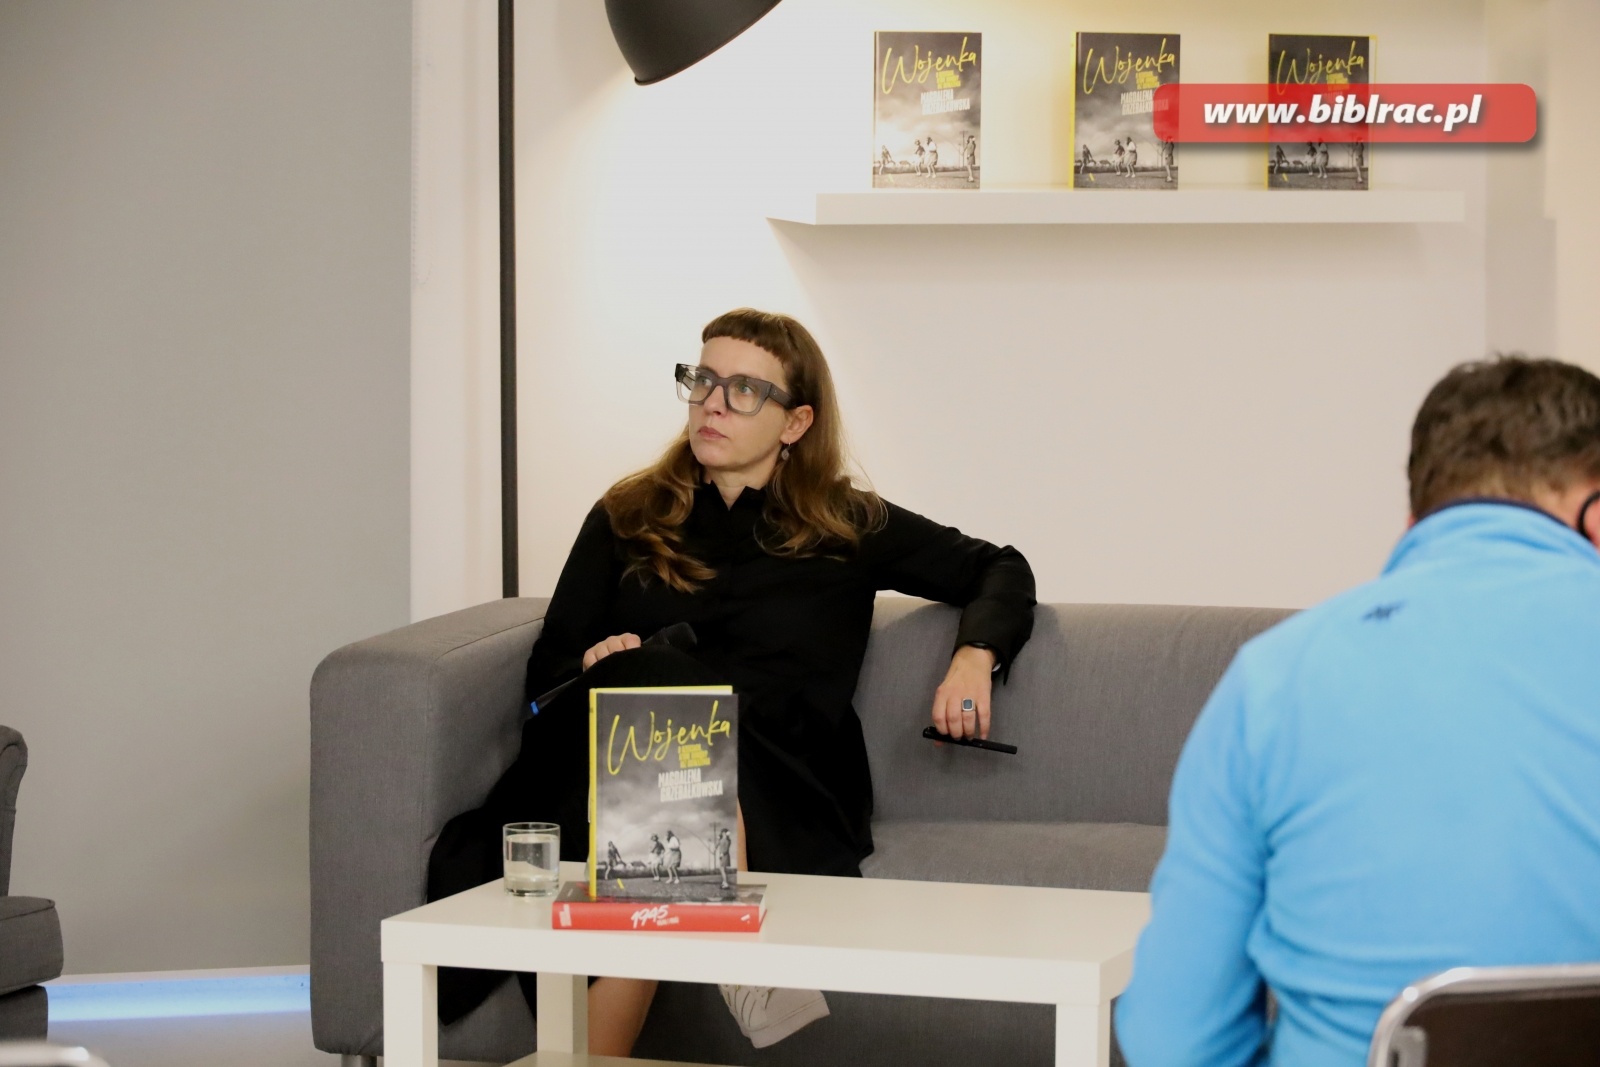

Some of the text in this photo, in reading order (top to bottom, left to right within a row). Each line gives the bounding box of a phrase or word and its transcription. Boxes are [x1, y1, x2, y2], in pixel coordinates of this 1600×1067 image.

[881, 36, 977, 95] Wojenka
[1083, 38, 1175, 95] Wojenka
[1276, 40, 1365, 96] Wojenka
[1120, 89, 1153, 105] MAGDALENA
[607, 700, 731, 776] Wojenka
[657, 768, 702, 788] MAGDALENA
[631, 904, 669, 929] 1945
